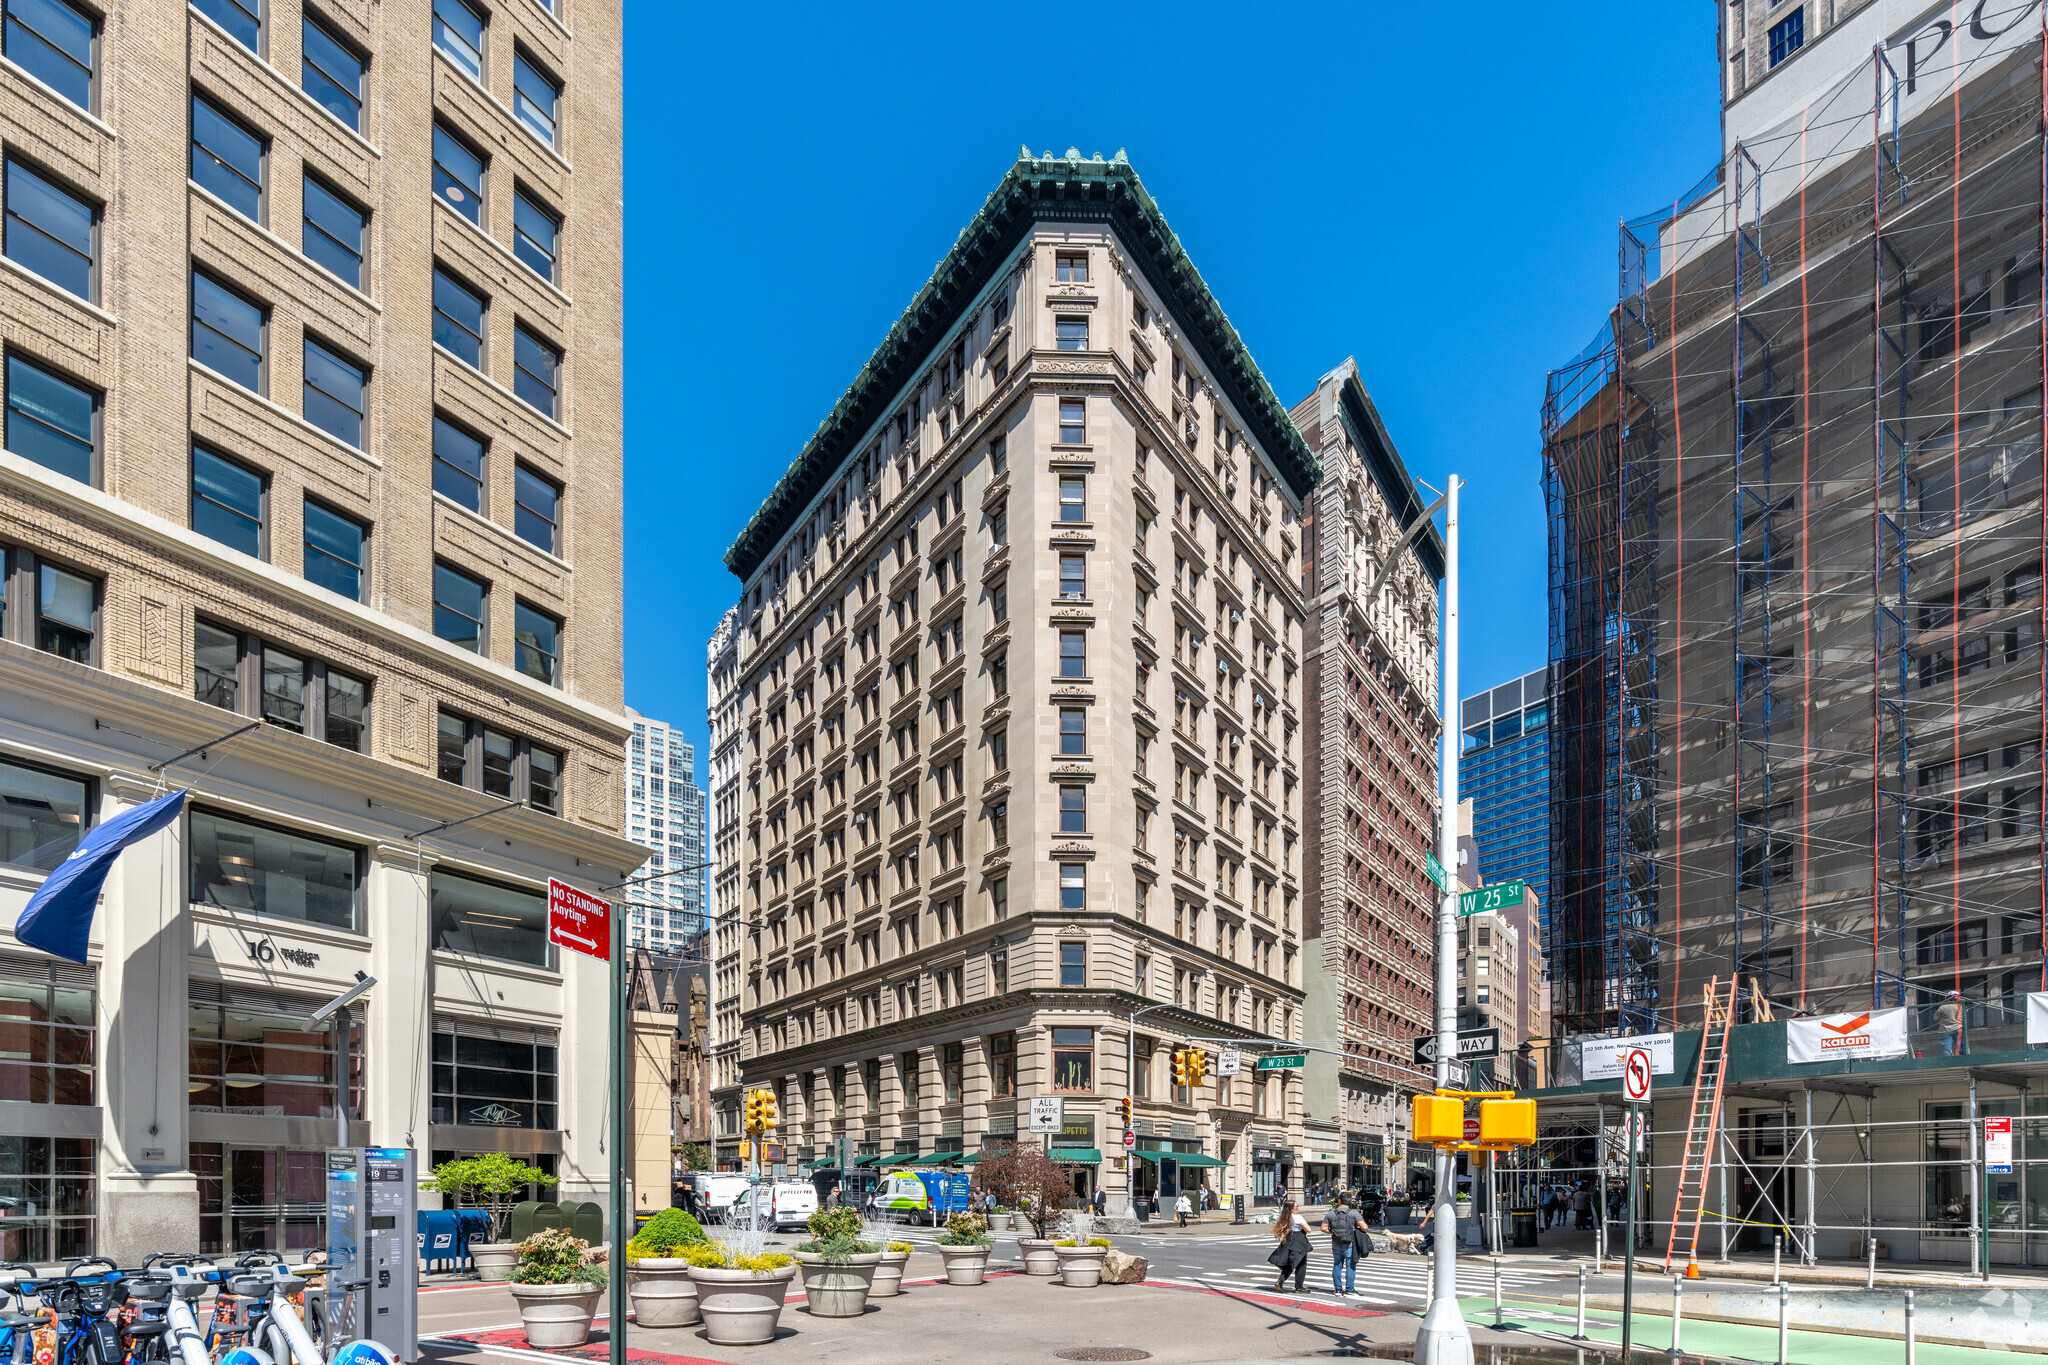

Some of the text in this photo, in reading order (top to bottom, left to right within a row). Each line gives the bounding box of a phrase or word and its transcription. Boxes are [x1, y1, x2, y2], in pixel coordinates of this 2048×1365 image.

[553, 886, 604, 917] NO STANDING
[1463, 884, 1519, 912] W 25 St
[553, 901, 587, 924] Anytime
[247, 939, 275, 963] 16
[1426, 1038, 1487, 1056] ON WAY
[1277, 1059, 1284, 1067] 25
[1287, 1058, 1294, 1066] St
[1063, 1127, 1088, 1135] UPETTO
[371, 1170, 380, 1178] 19
[355, 1355, 381, 1365] citi bike
